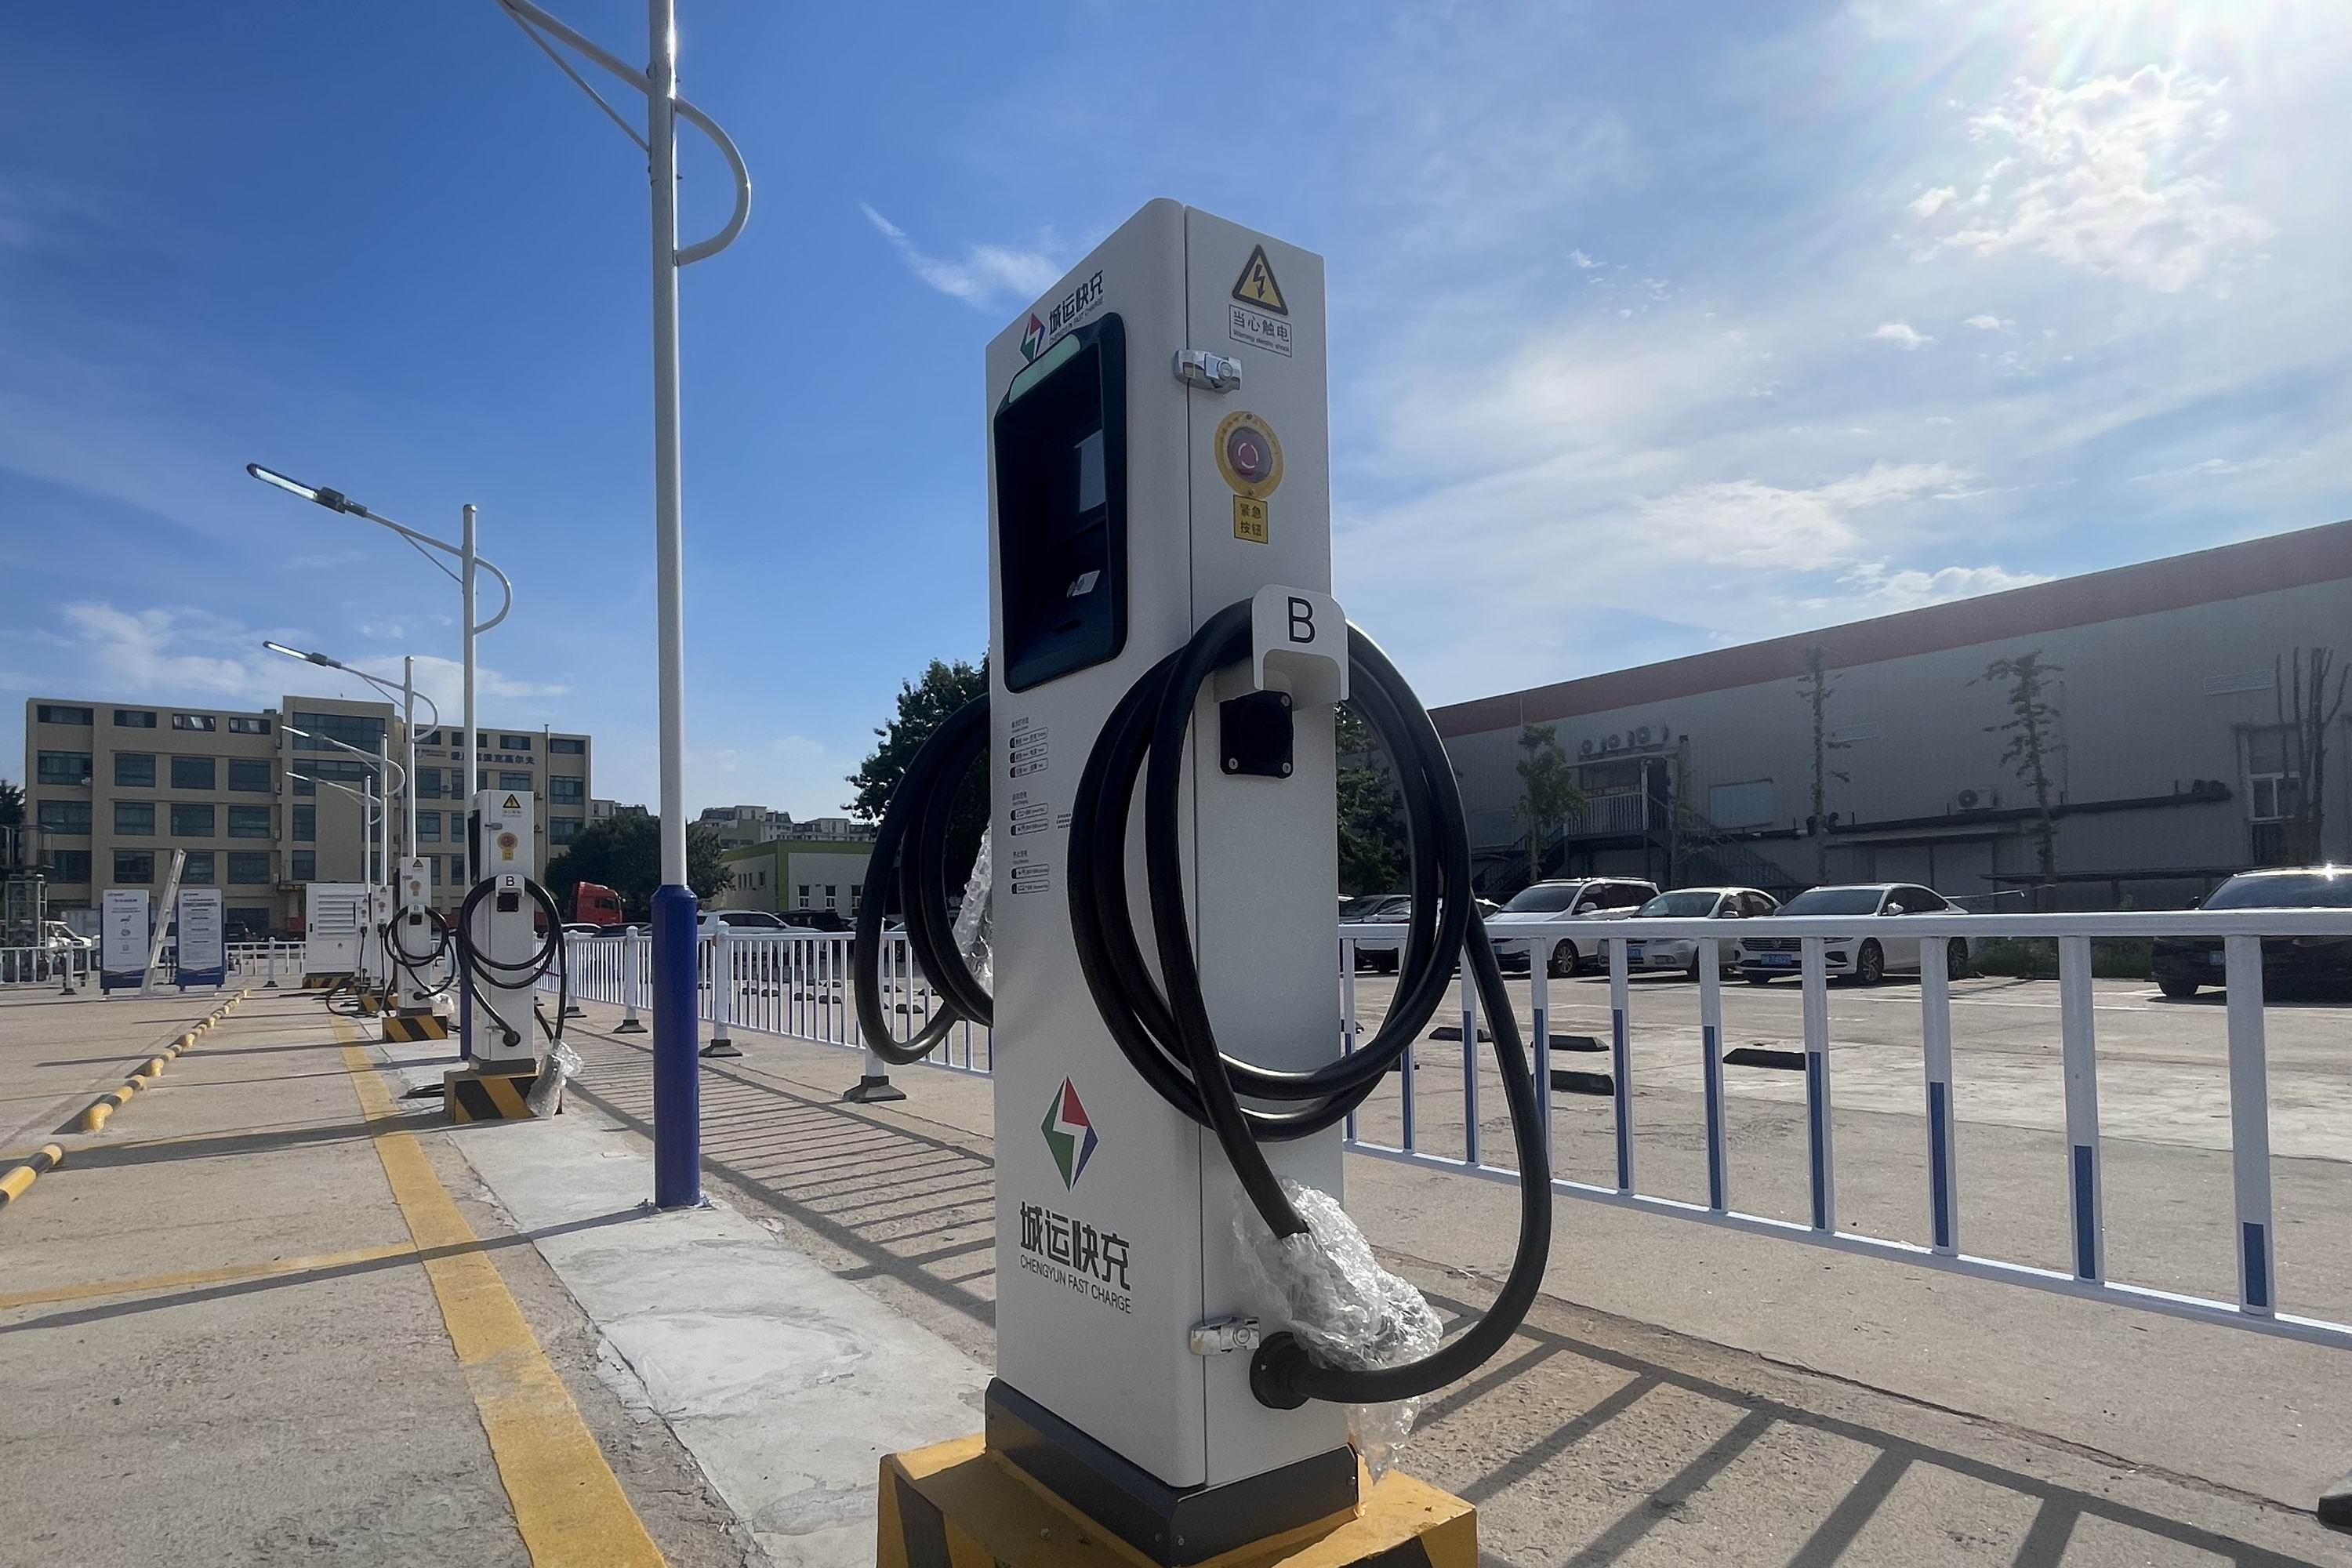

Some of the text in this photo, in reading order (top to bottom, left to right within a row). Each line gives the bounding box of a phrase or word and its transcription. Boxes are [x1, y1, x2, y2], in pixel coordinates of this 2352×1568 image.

[1049, 270, 1103, 335] 城运快充
[1233, 310, 1290, 343] 当心触电
[1240, 503, 1261, 518] 紧急
[1240, 520, 1261, 536] 按钮
[1287, 596, 1316, 644] B
[506, 876, 515, 887] B
[1020, 1200, 1131, 1292] 城运快充
[1020, 1254, 1131, 1315] CHENGYUN FAST CHARGE
